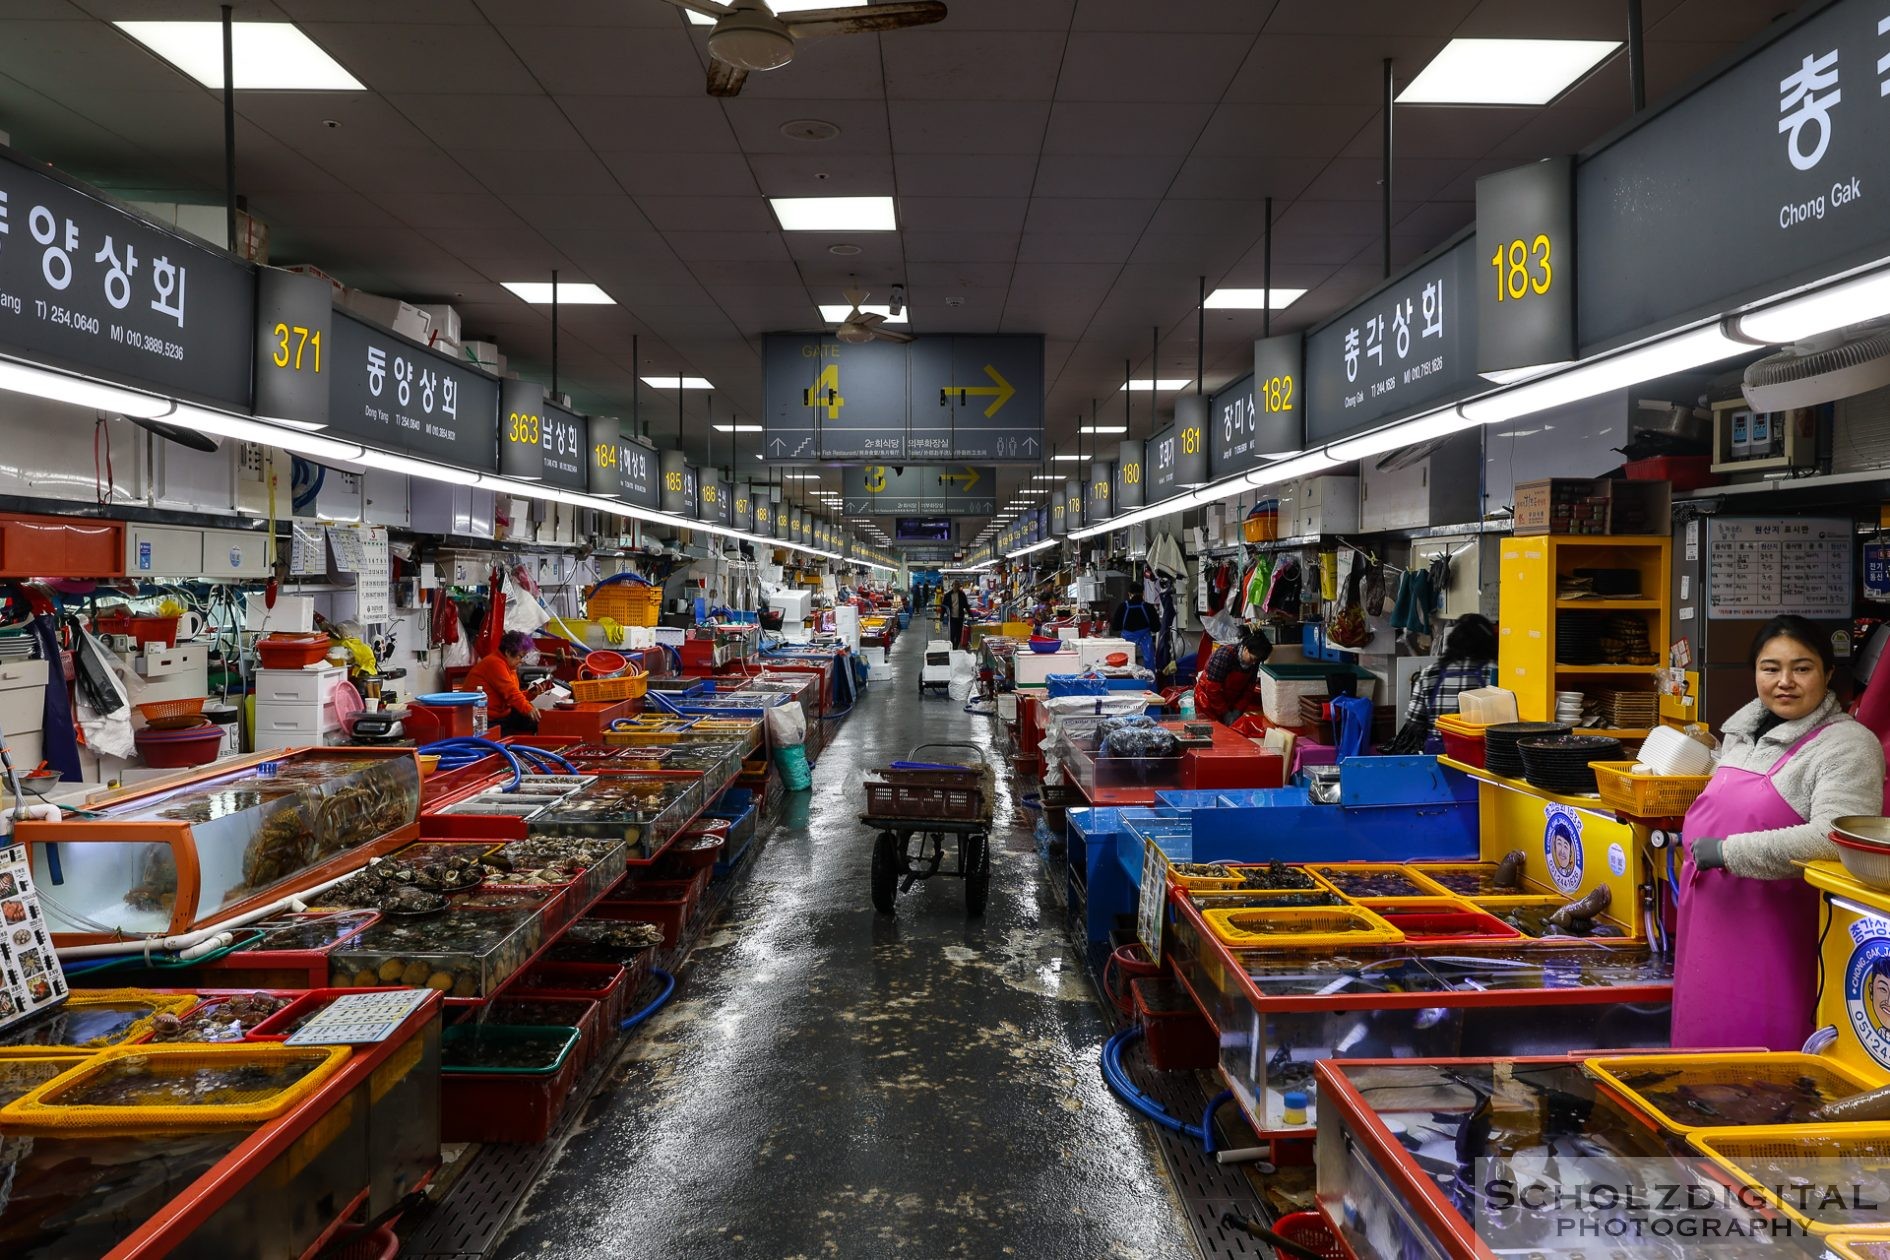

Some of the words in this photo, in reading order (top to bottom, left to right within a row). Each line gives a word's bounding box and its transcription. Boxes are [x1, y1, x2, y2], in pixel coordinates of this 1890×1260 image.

[1779, 195, 1825, 229] Chong
[1831, 176, 1862, 208] Gak
[0, 190, 186, 329] 양상회
[1491, 233, 1552, 302] 183
[0, 289, 22, 315] ang
[51, 305, 99, 335] 254.0640
[126, 329, 184, 361] 010.3889.5236
[1344, 278, 1443, 383] 총각상회
[273, 322, 321, 374] 371
[802, 344, 841, 358] GATE
[366, 345, 458, 421] 동양상회
[805, 363, 845, 420] 4
[1262, 375, 1293, 413] 182
[509, 412, 539, 444] 363
[1181, 426, 1200, 454] 181
[594, 443, 616, 468] 184
[665, 471, 682, 491] 185
[864, 466, 887, 493] 3
[1123, 462, 1140, 484] 180
[702, 485, 716, 502] 186
[1094, 481, 1109, 499] 179
[736, 499, 748, 514] 187
[756, 507, 768, 521] 188
[1054, 506, 1065, 520] 177
[1068, 497, 1080, 513] 178
[1850, 917, 1890, 944] 총각상
